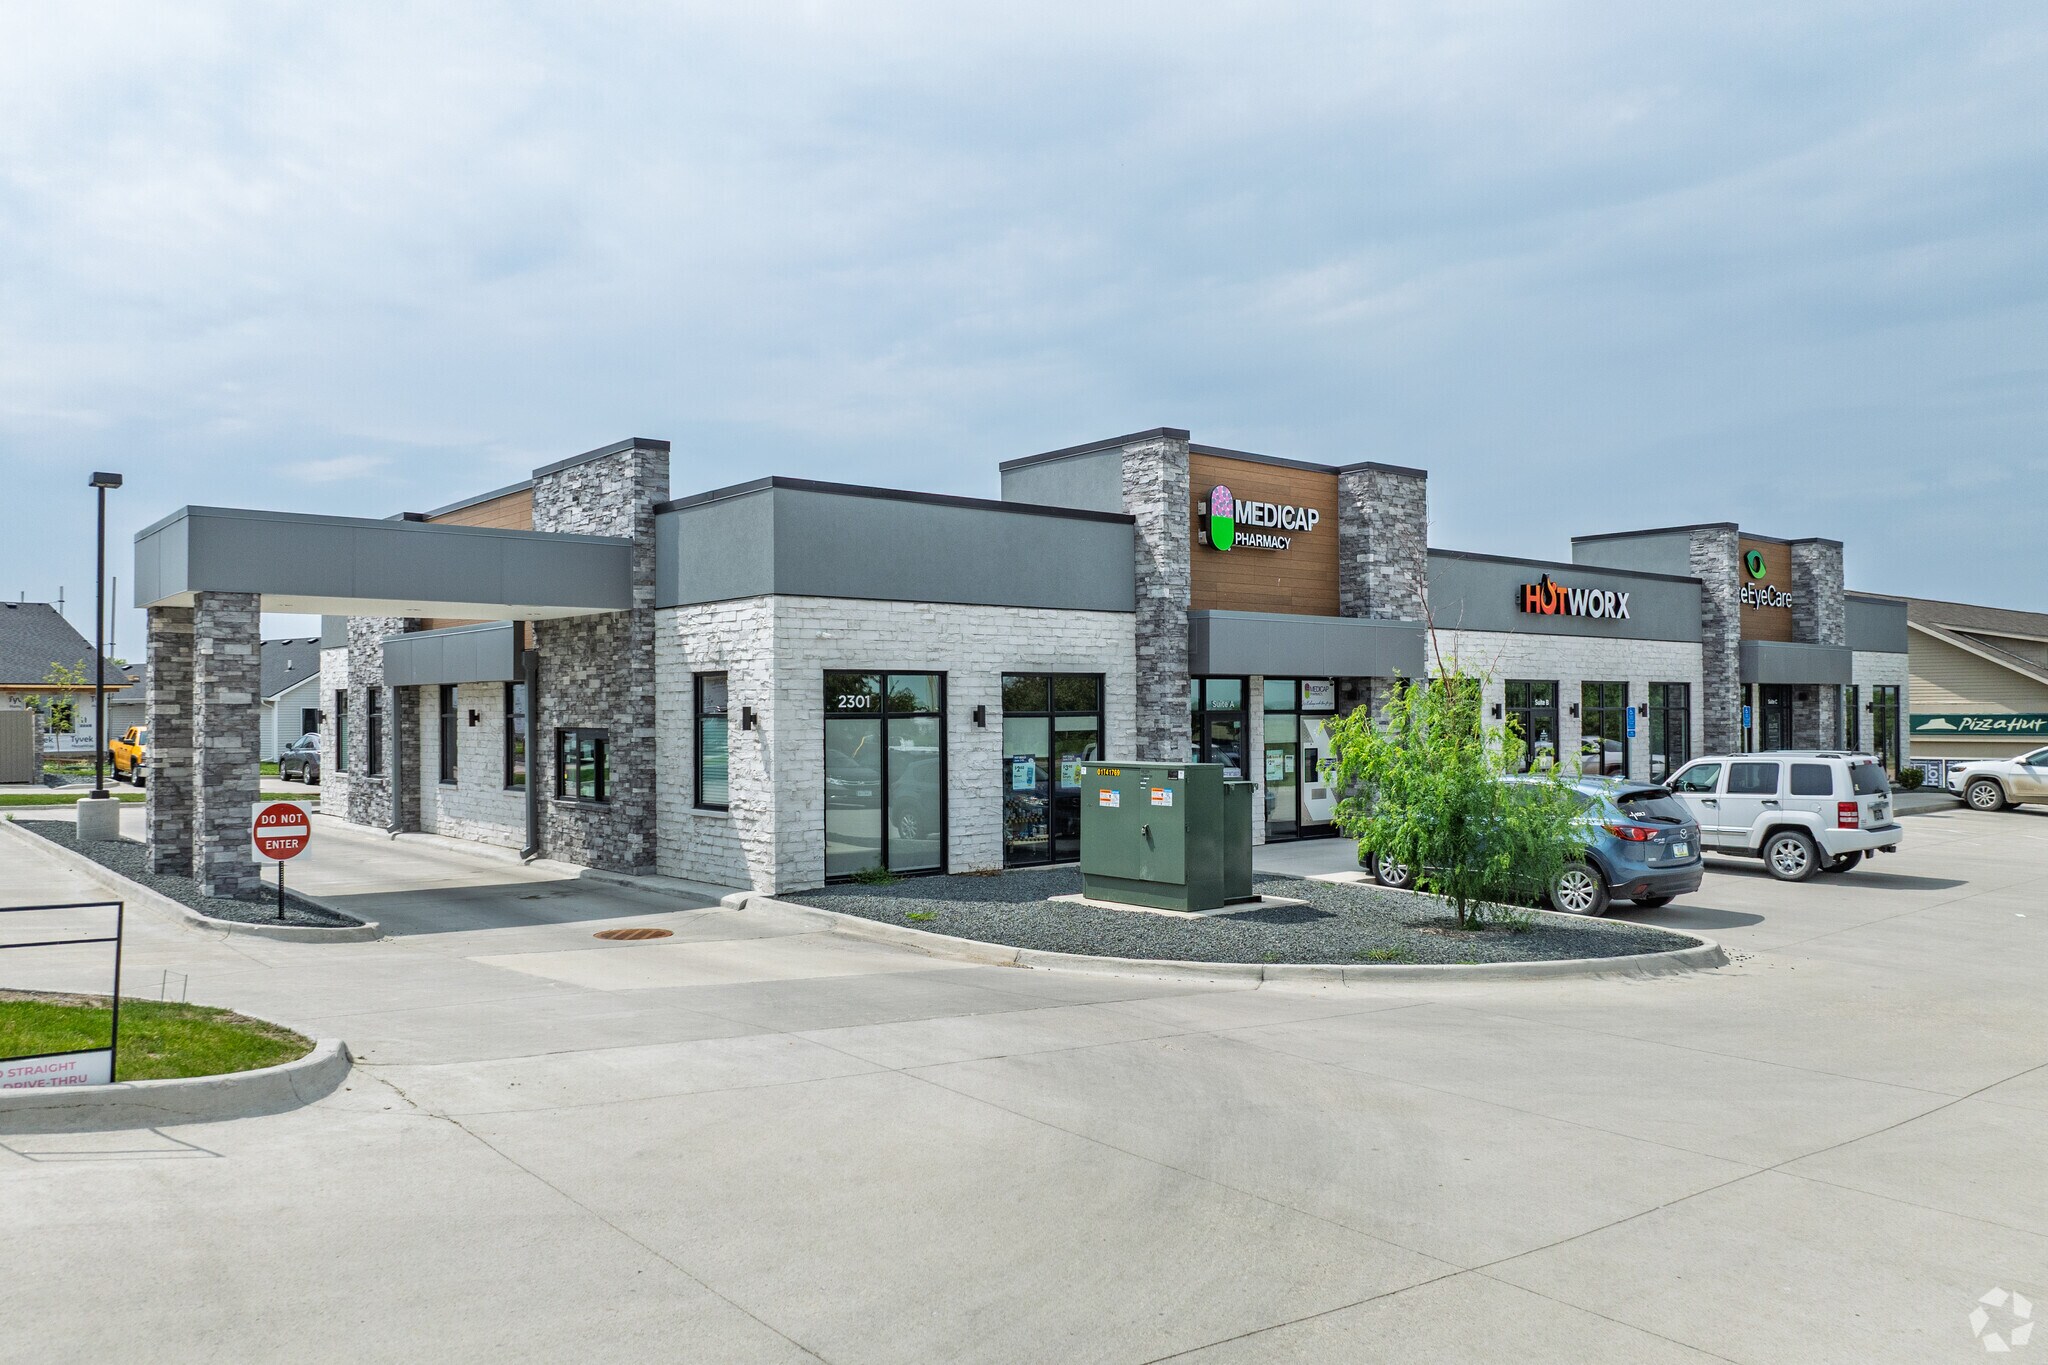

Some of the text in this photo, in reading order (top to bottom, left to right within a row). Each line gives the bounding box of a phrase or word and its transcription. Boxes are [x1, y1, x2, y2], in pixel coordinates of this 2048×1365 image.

[1235, 499, 1320, 532] MEDICAP
[1235, 532, 1291, 550] PHARMACY
[1525, 574, 1630, 619] HOTWORX
[1739, 582, 1793, 610] eEyeCare
[838, 694, 871, 709] 2301
[1211, 700, 1235, 708] Suite A
[70, 735, 94, 743] Tyvek
[1928, 764, 1939, 786] HOT
[261, 813, 303, 825] DO NOT
[265, 839, 299, 850] ENTER
[7, 1061, 77, 1078] STRAIGHT
